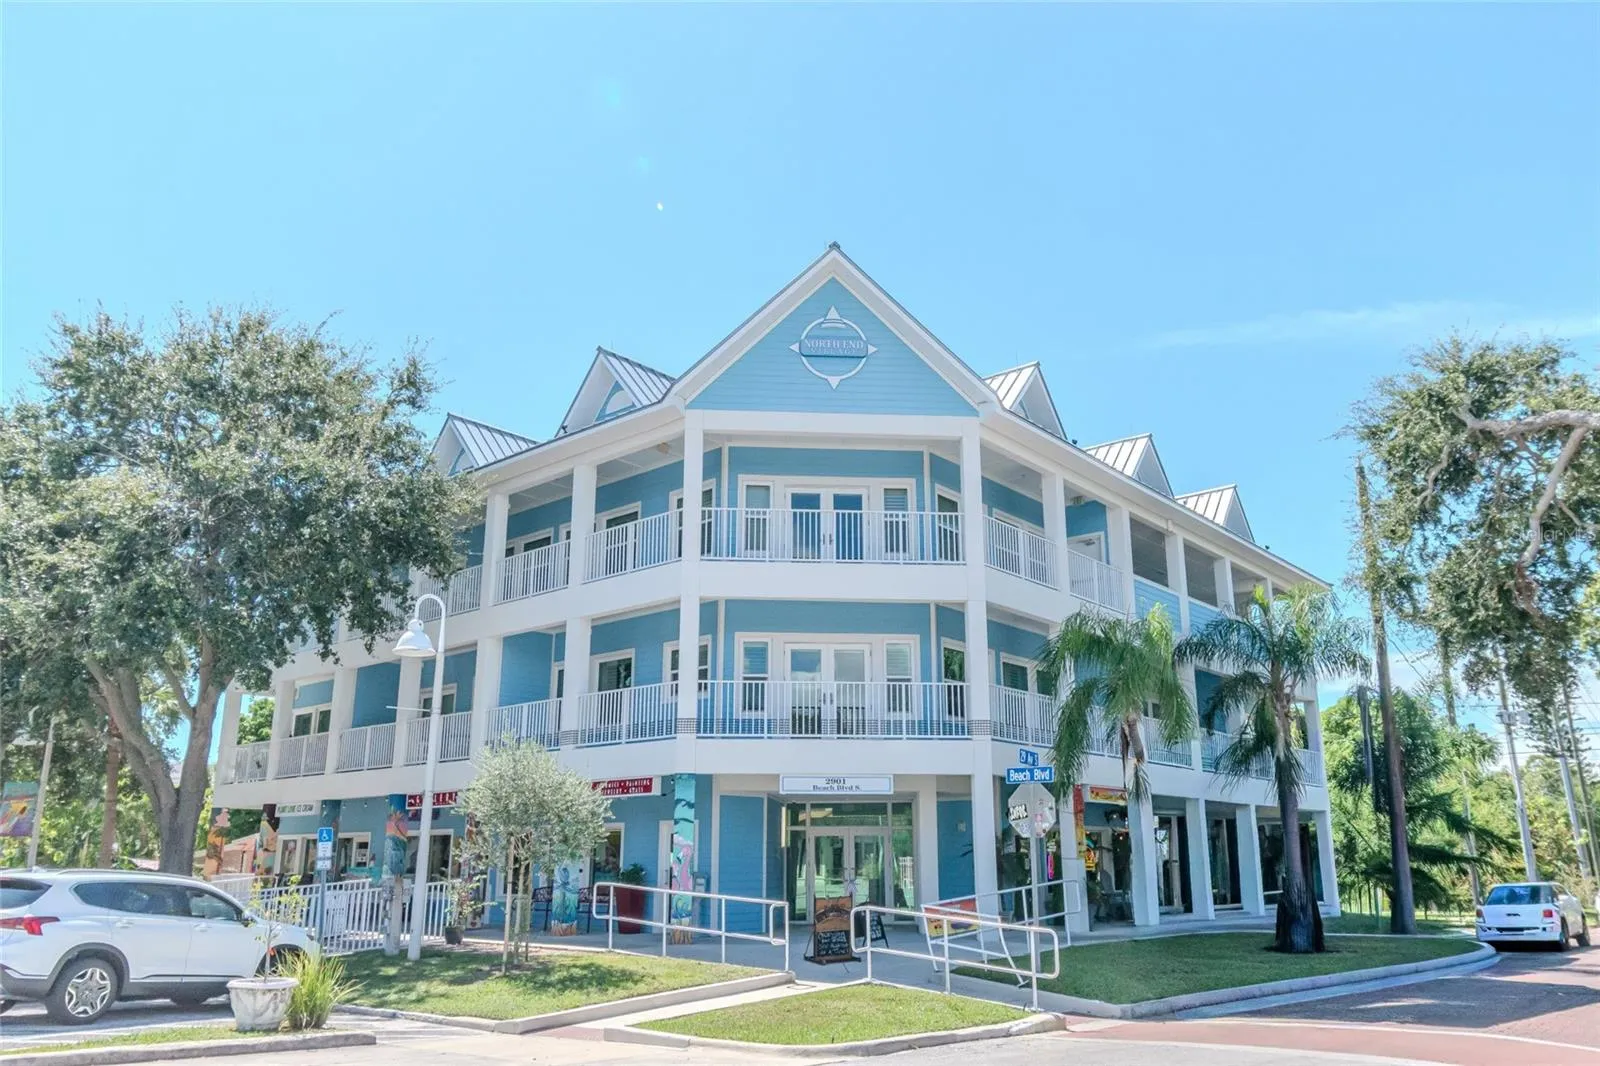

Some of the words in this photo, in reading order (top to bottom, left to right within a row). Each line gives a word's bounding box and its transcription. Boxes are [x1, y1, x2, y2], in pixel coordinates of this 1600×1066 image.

[805, 339, 840, 348] NORTH
[843, 339, 864, 349] END
[1010, 769, 1031, 781] Beach
[1034, 768, 1050, 780] Blvd
[825, 777, 846, 785] 2901
[837, 784, 854, 792] Blvd
